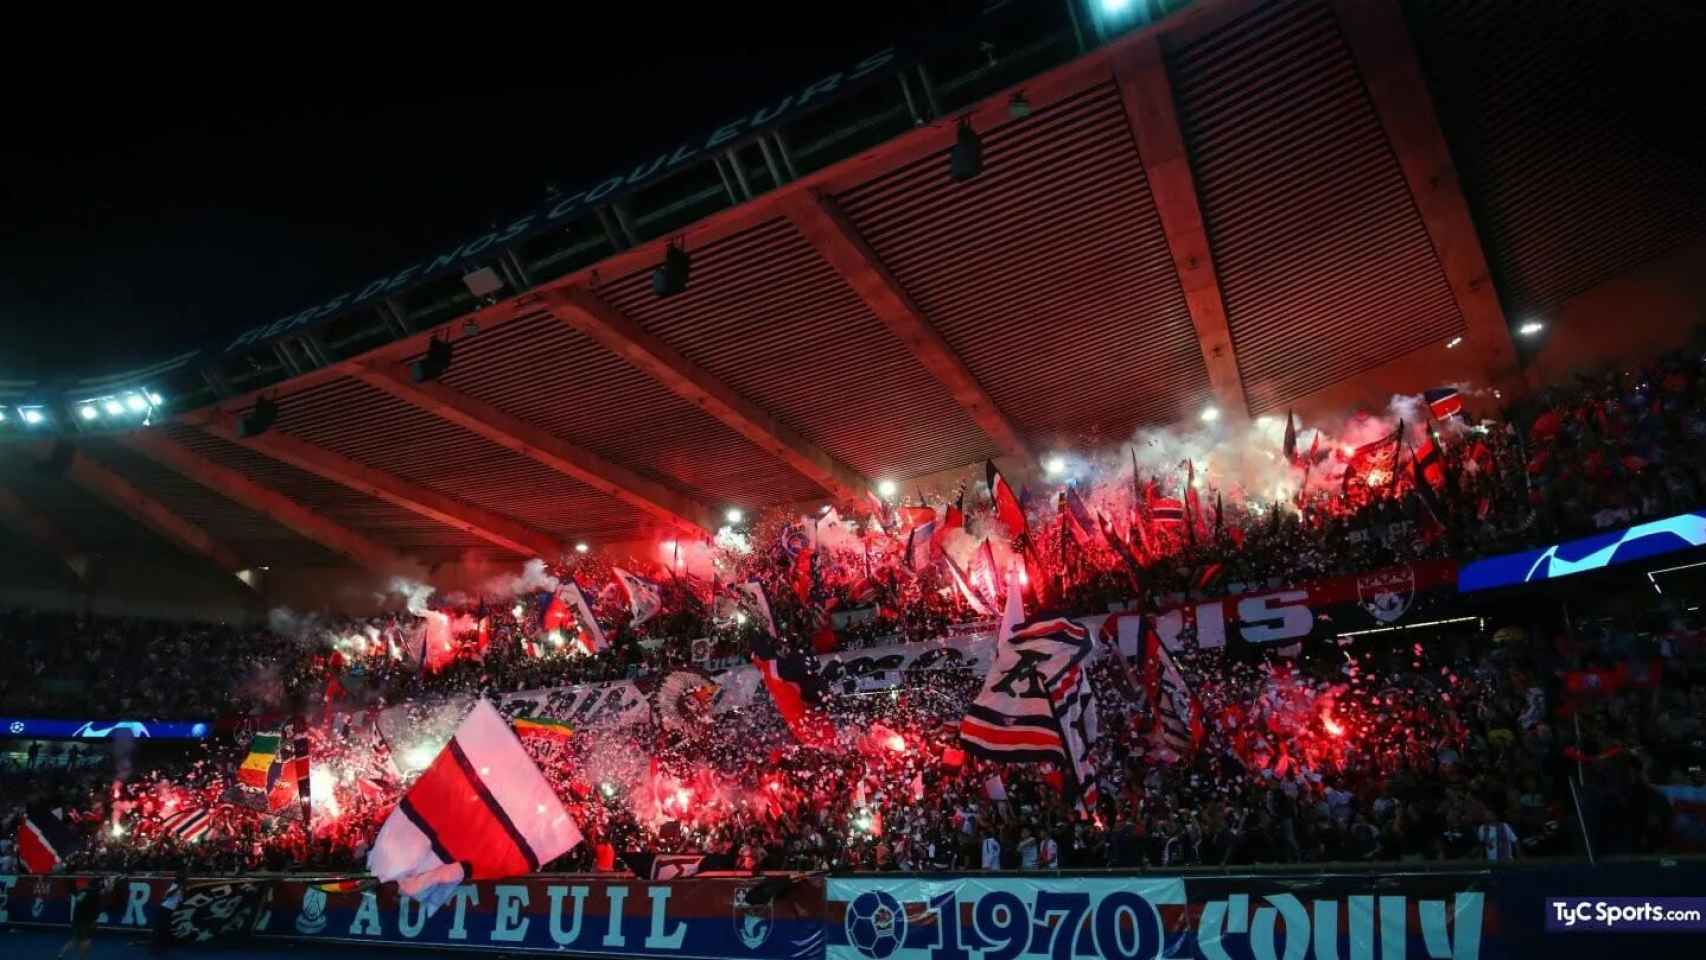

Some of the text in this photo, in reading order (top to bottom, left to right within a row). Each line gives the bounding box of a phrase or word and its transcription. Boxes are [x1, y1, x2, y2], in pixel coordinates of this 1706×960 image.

[424, 213, 537, 274] NOS
[546, 47, 896, 219] COULEURS
[350, 885, 687, 949] AUTEUIL
[926, 890, 1165, 960] 1970
